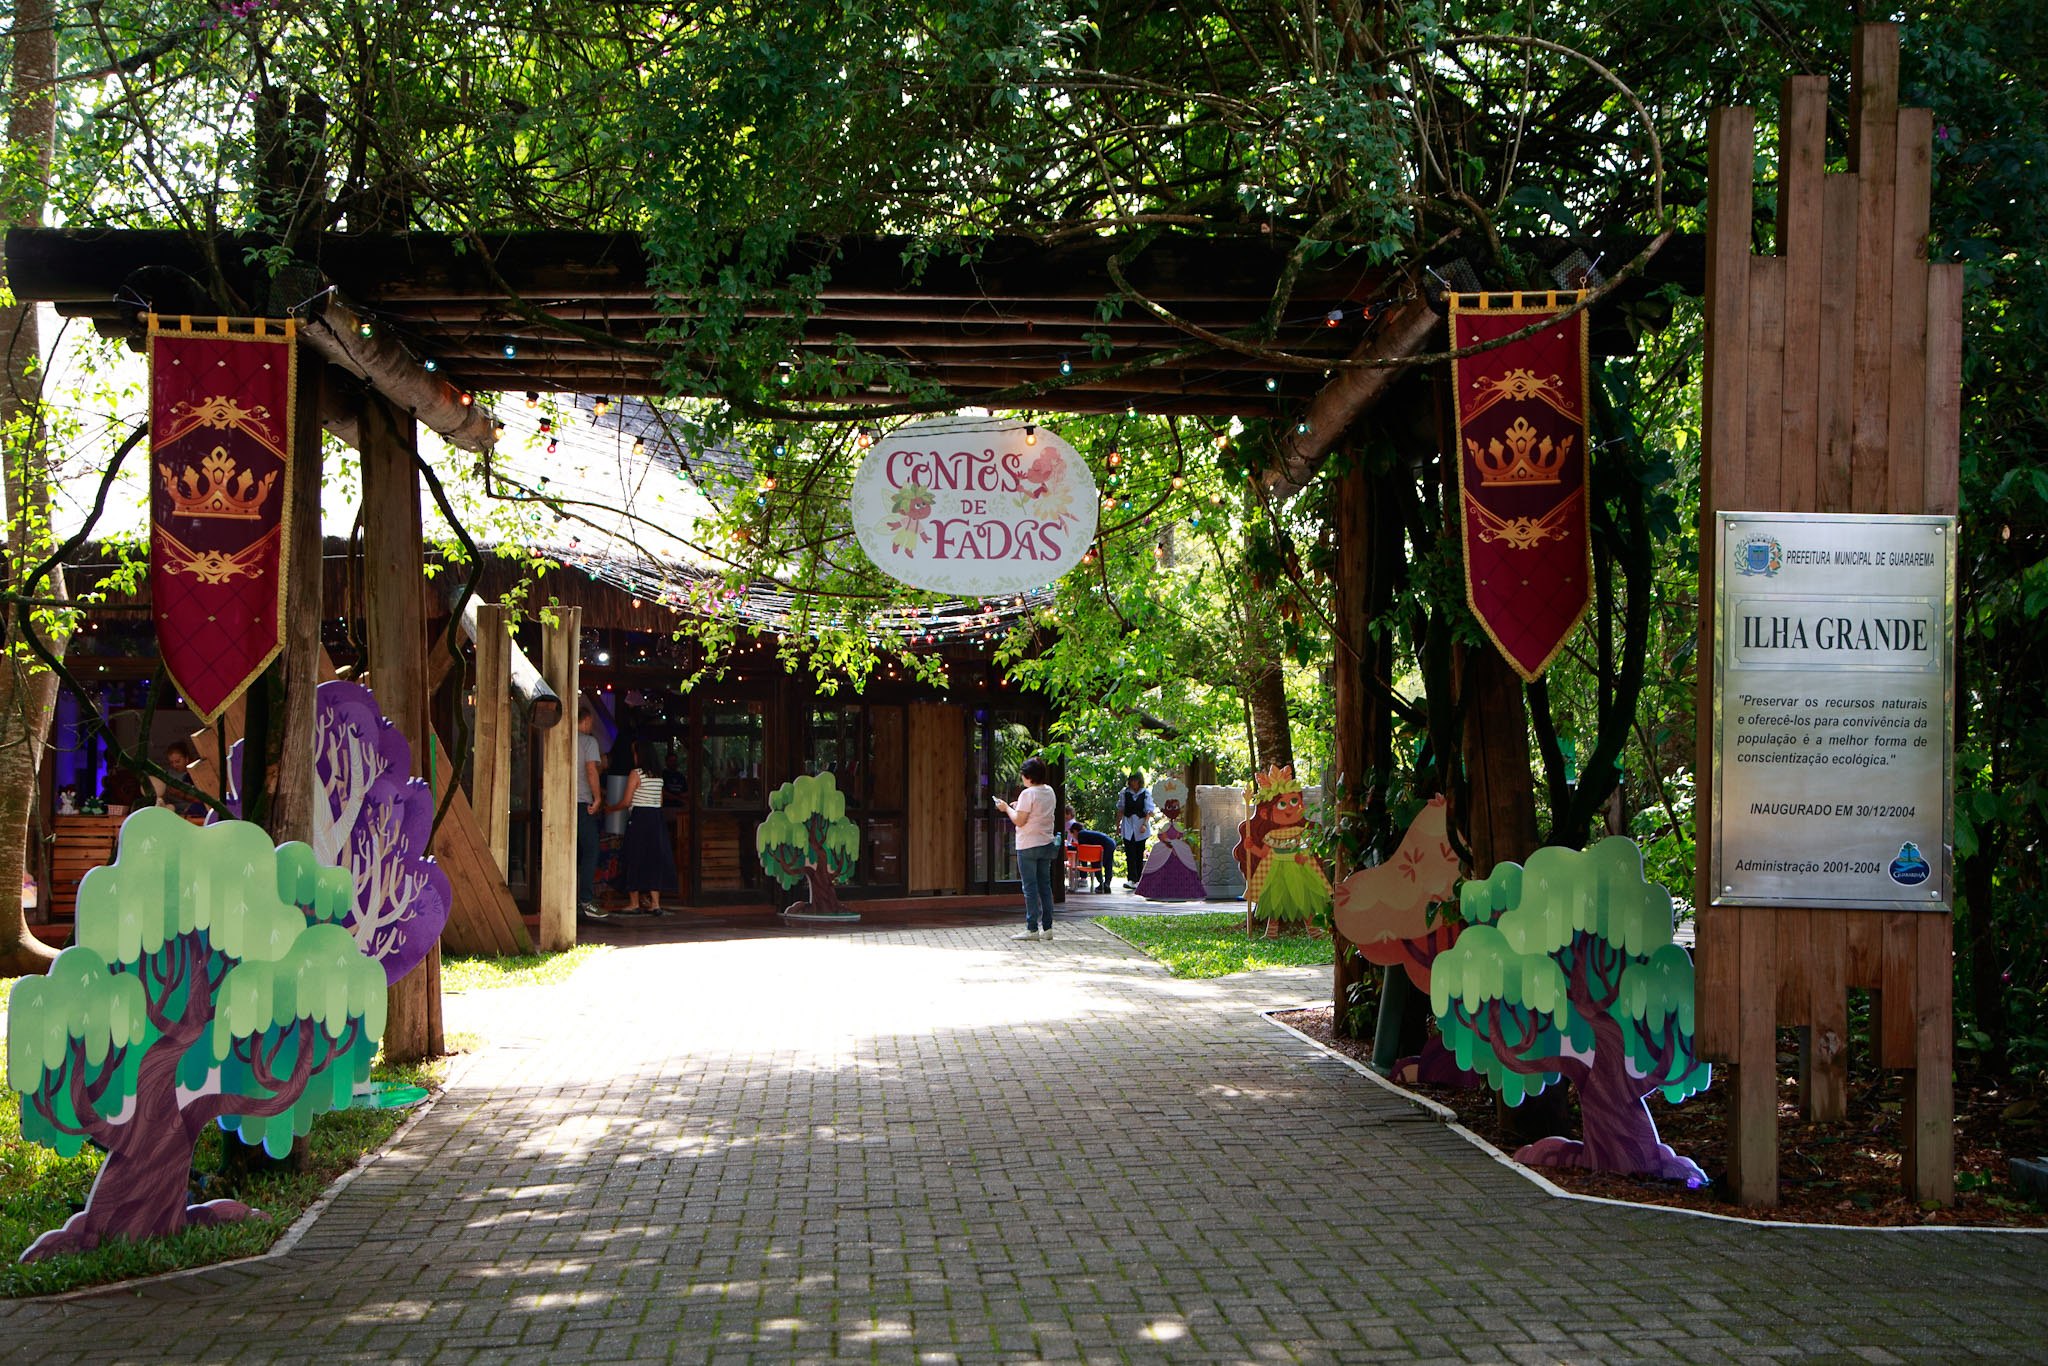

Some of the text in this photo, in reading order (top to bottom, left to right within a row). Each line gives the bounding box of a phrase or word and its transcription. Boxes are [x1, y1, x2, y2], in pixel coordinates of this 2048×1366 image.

[886, 449, 1023, 493] CONTOS
[961, 500, 986, 515] DE
[929, 519, 1063, 561] FADAS
[1786, 550, 1935, 567] PREFEITURA MUNICIPAL DE GUARAREMA
[1743, 616, 1927, 651] ILHA GRANDE
[1739, 694, 1928, 710] "Preservar os recursos naturais
[1737, 713, 1927, 728] e oferecê-los para convivência da
[1737, 733, 1927, 747] população é a melhor forma de
[1737, 752, 1897, 767] conscientização ecológica."
[1750, 803, 1915, 817] INAUGURADO EM 30/12/2004
[1735, 859, 1881, 875] Administração 2001-2004
